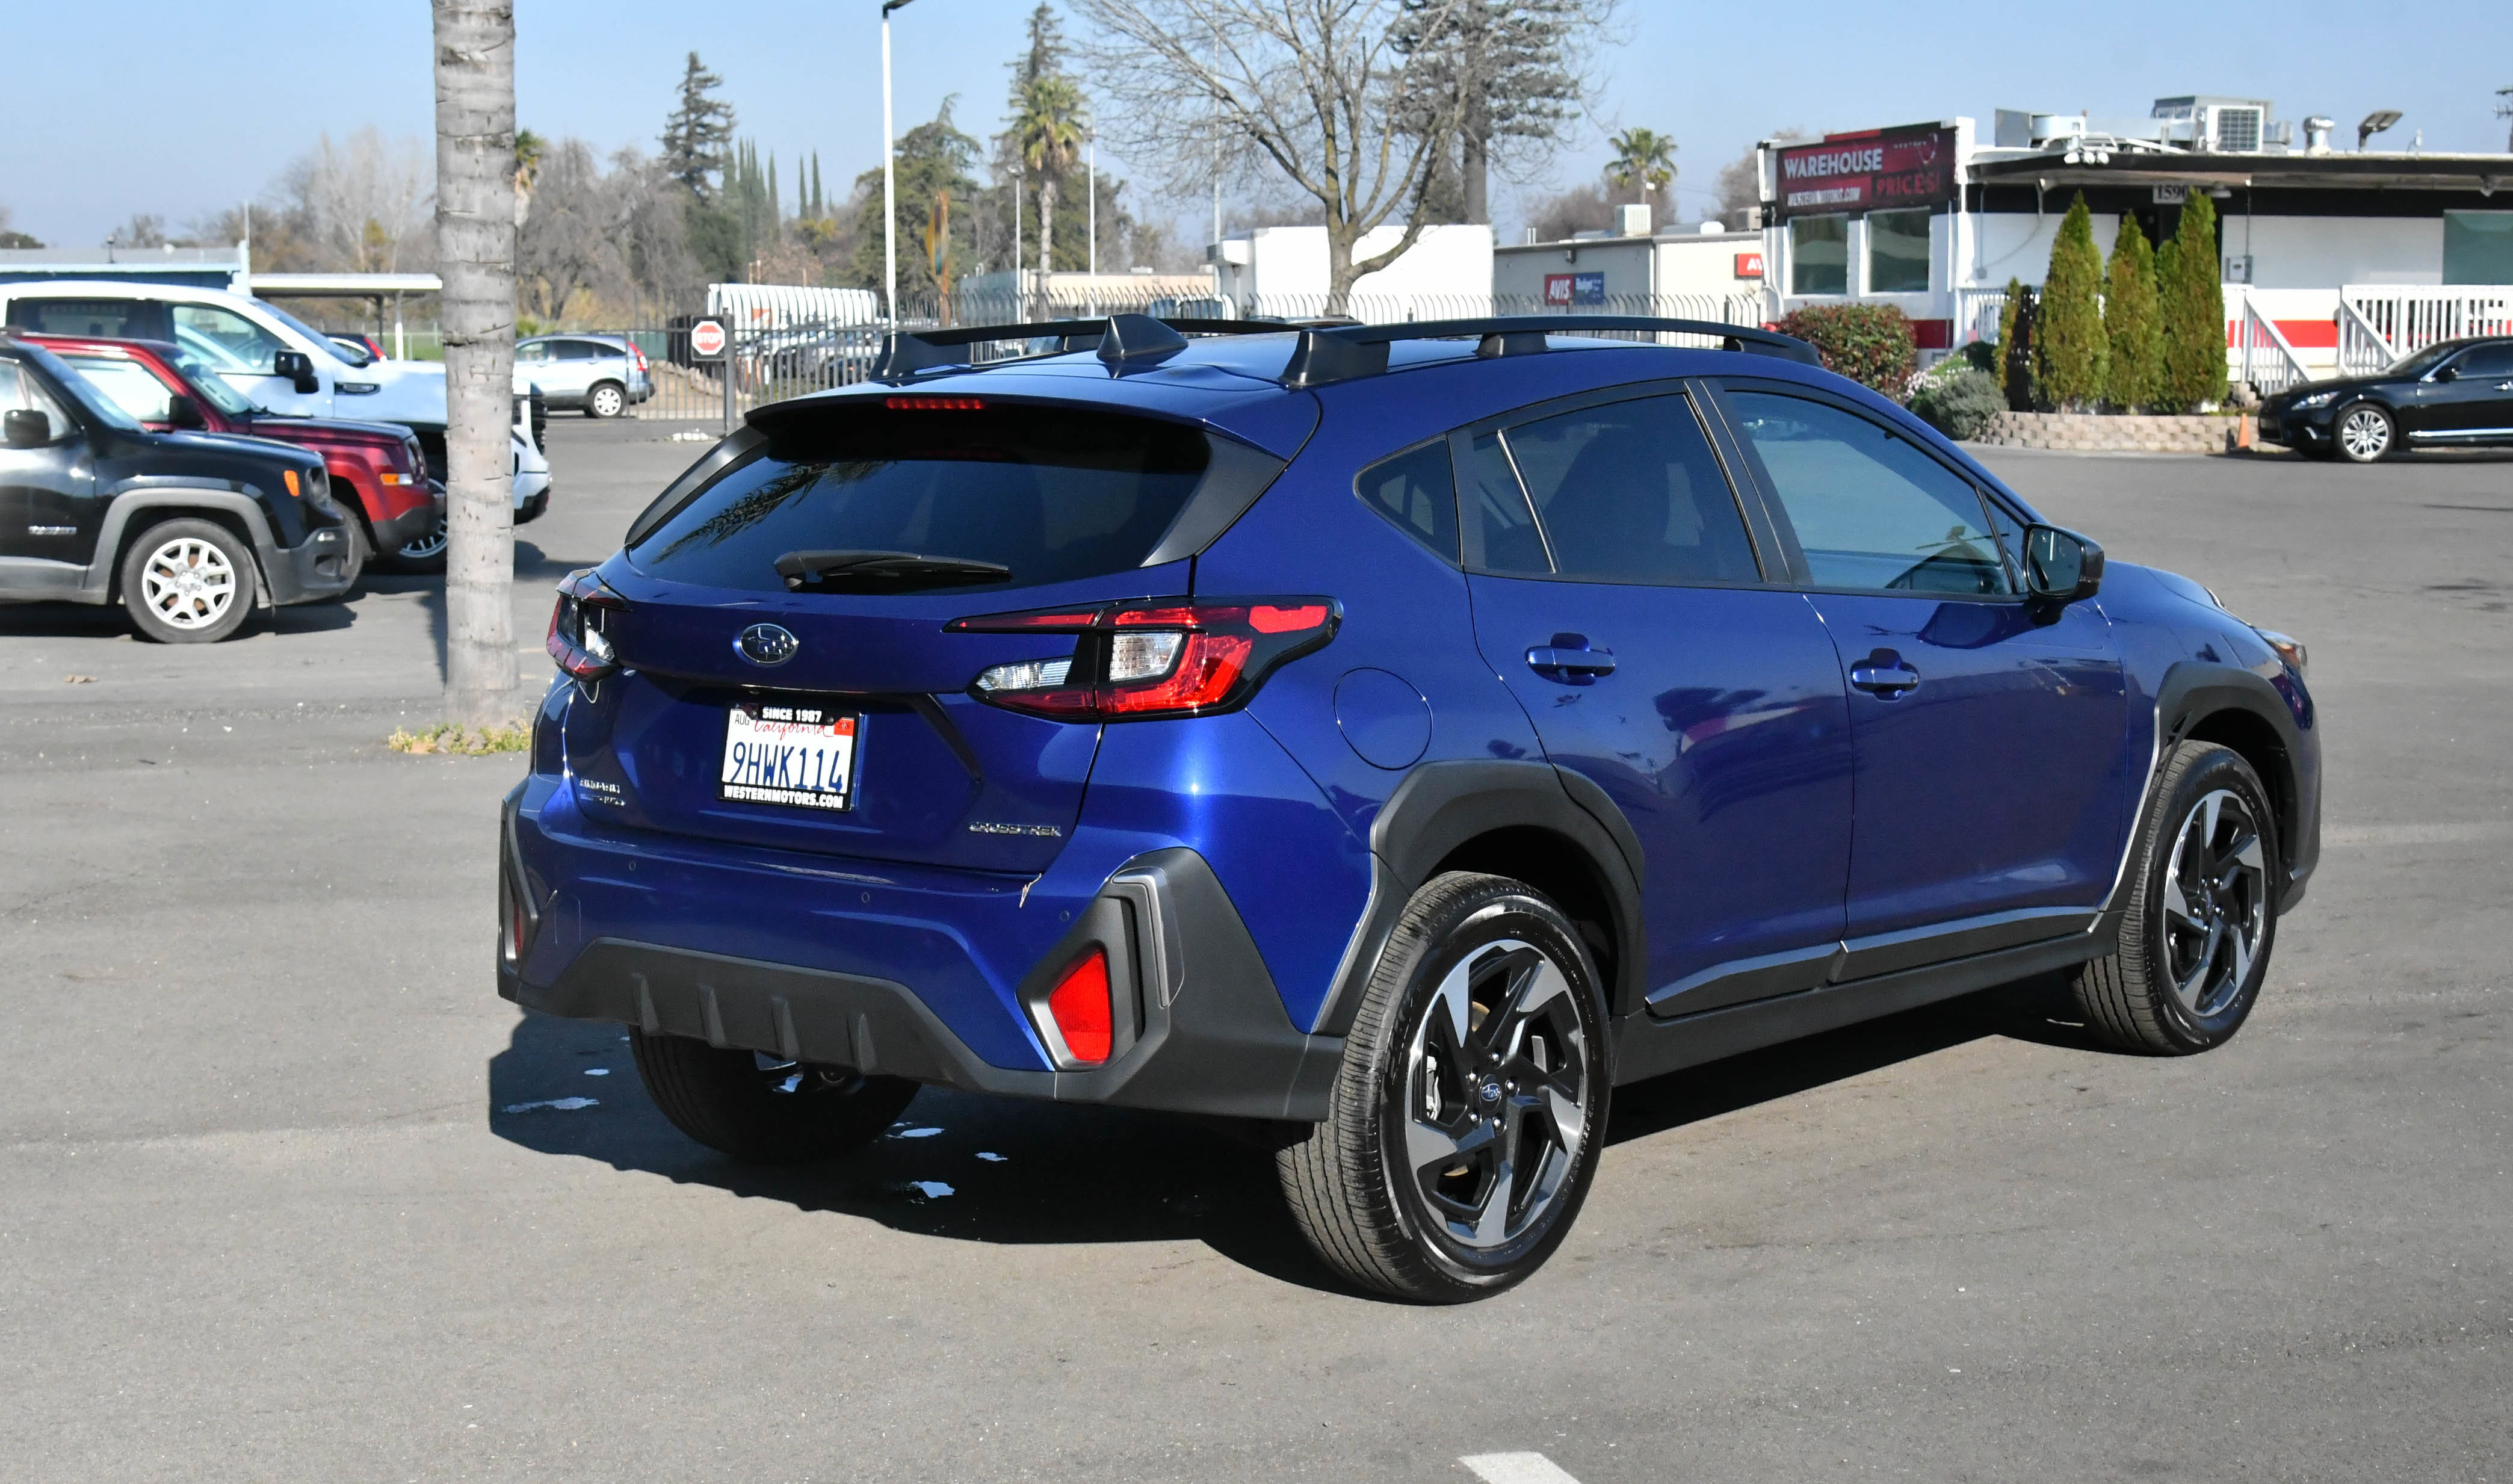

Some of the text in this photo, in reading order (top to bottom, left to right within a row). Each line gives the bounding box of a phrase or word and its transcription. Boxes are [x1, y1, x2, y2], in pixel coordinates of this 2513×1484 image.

[1784, 148, 1883, 178] WAREHOUSE
[1548, 279, 1570, 300] AVIS
[696, 332, 722, 344] STOP
[735, 713, 750, 726] AUG
[762, 706, 823, 723] SINCE 1987
[730, 741, 843, 793] 9HWK114
[724, 785, 844, 809] WESTERNMOTORS.COM
[969, 821, 1062, 837] CROSSTREK
